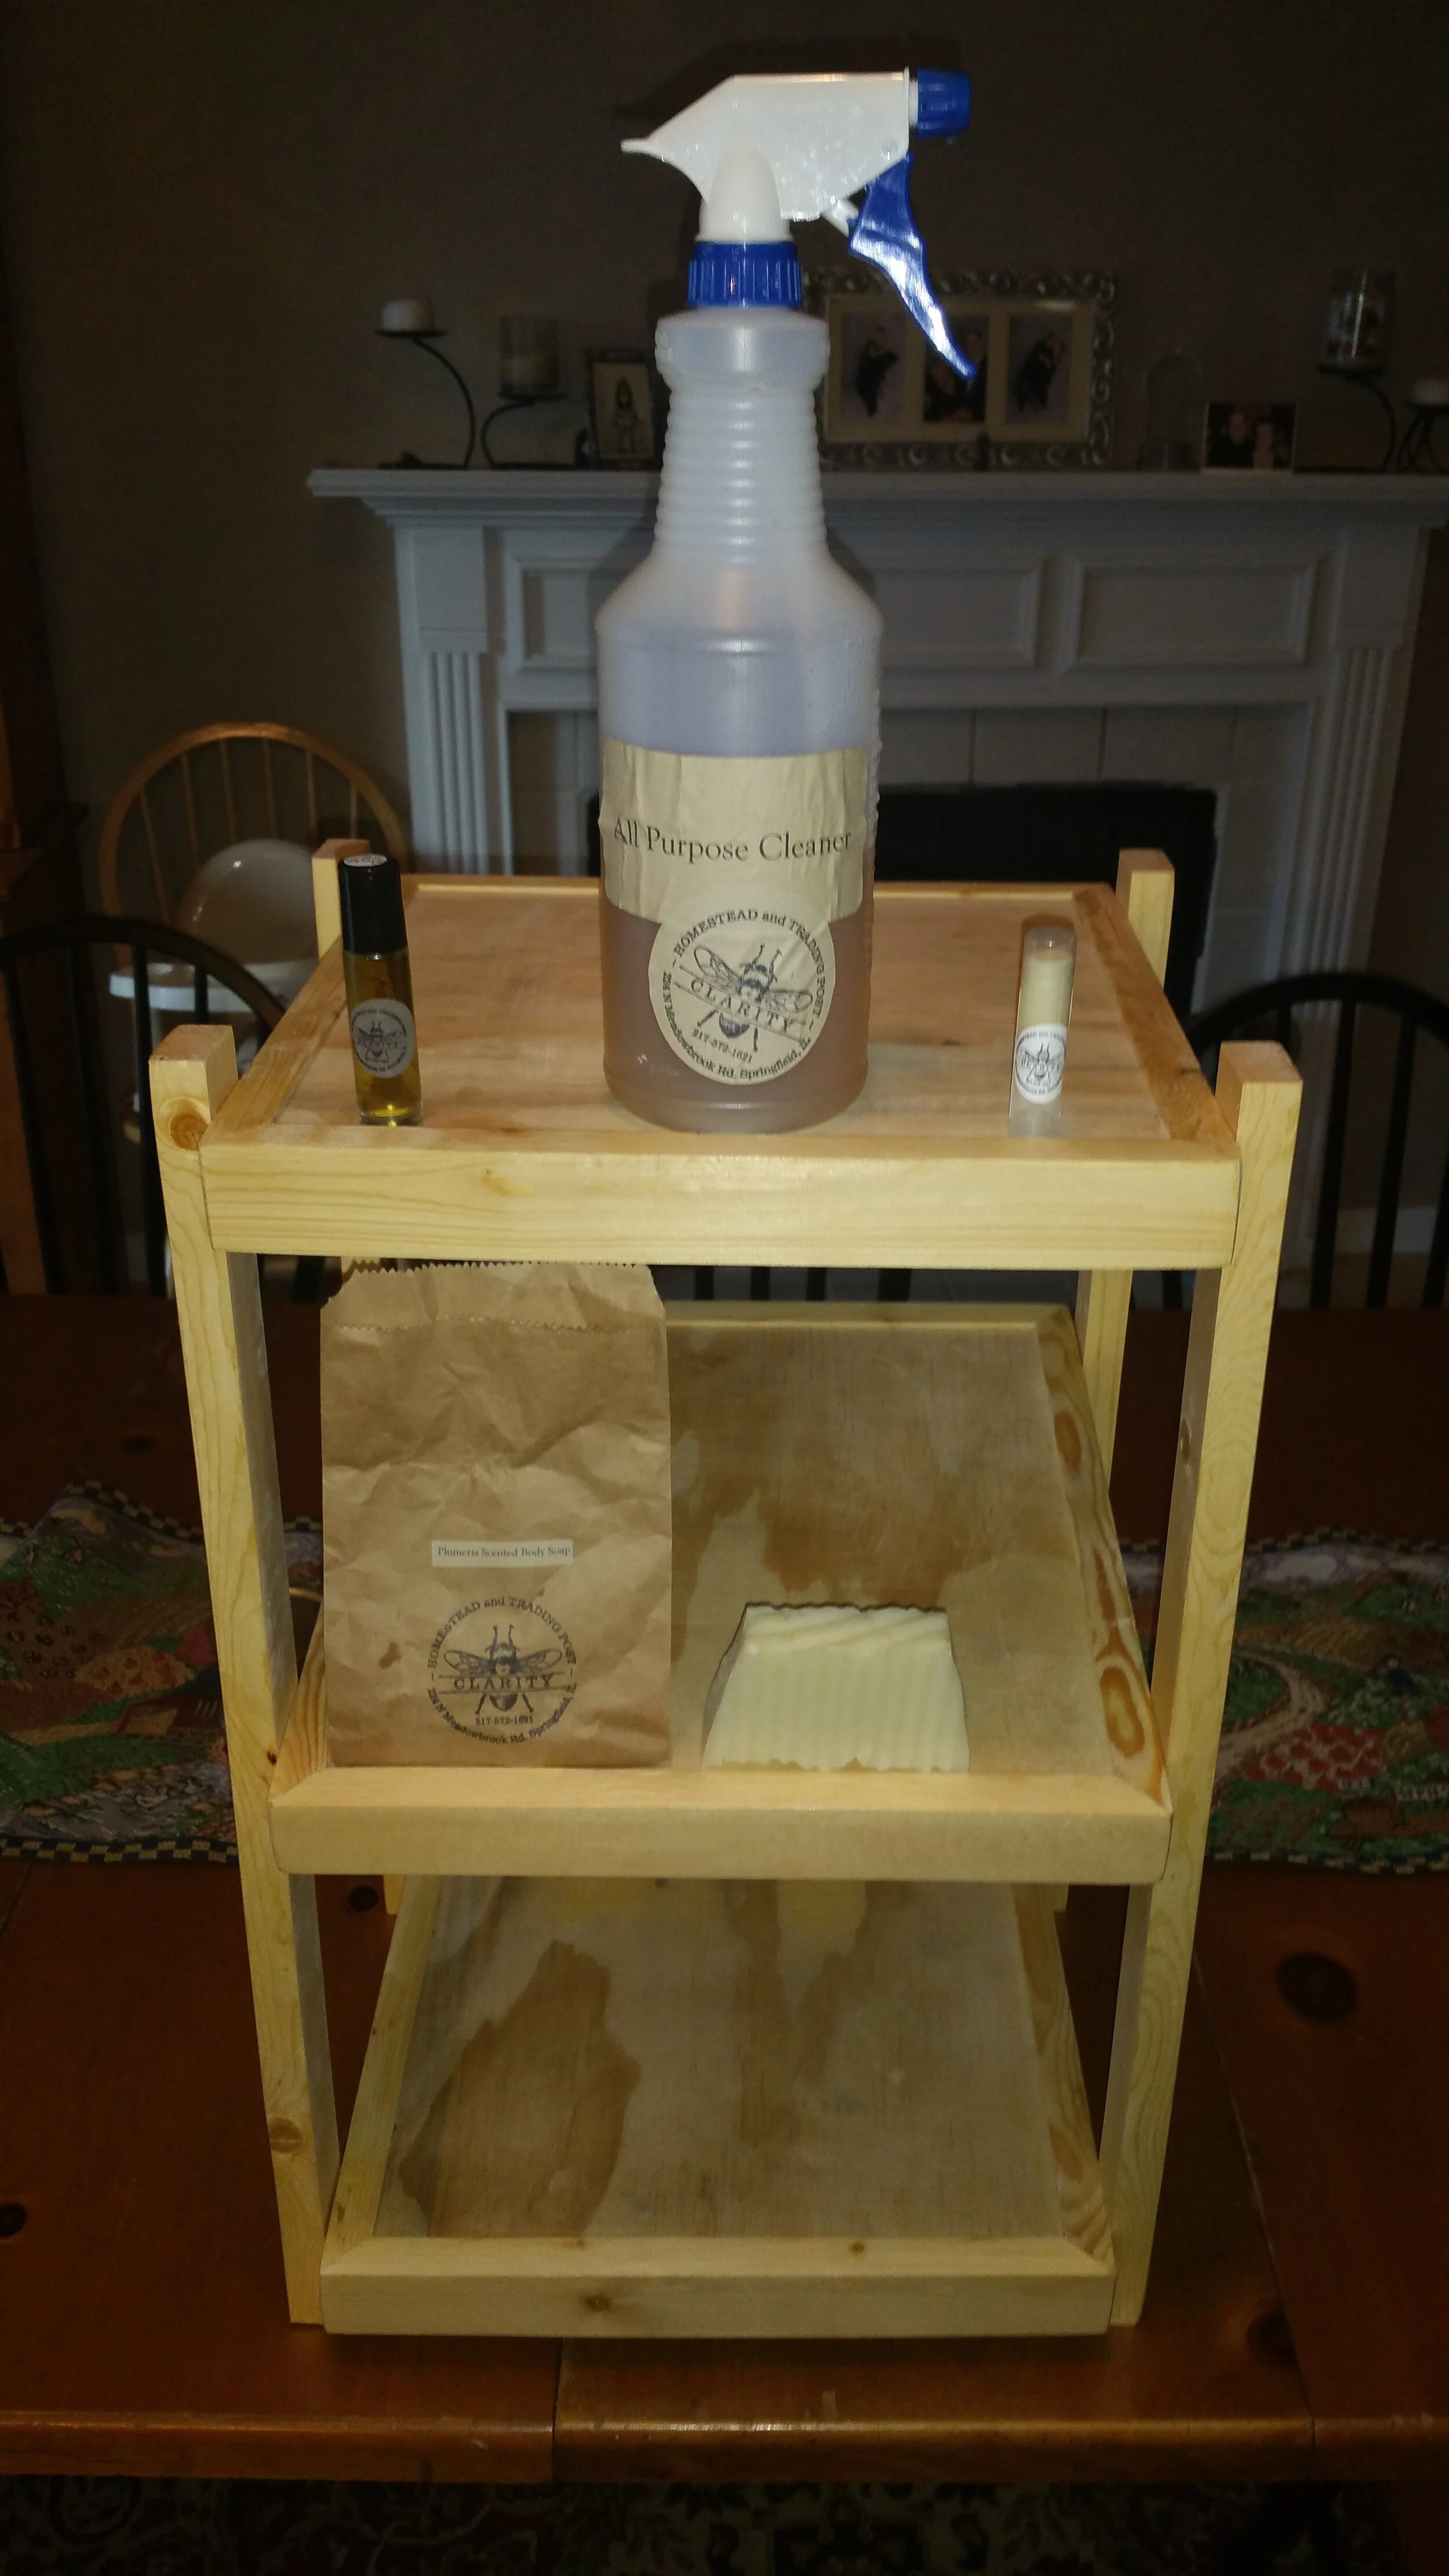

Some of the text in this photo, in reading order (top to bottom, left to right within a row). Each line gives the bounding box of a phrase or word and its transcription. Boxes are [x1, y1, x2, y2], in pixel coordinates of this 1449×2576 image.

[614, 817, 851, 865] All Purpose Cleaner
[673, 909, 759, 958] HOMESTEAD
[762, 912, 787, 927] and
[690, 979, 798, 1032] CLARITY
[438, 1545, 571, 1558] Plumeria Scented Body Soap
[428, 1600, 481, 1669] HOMESTEAD
[483, 1596, 505, 1608] and
[508, 1595, 562, 1633] TRADING
[454, 1673, 553, 1689] CLARITY
